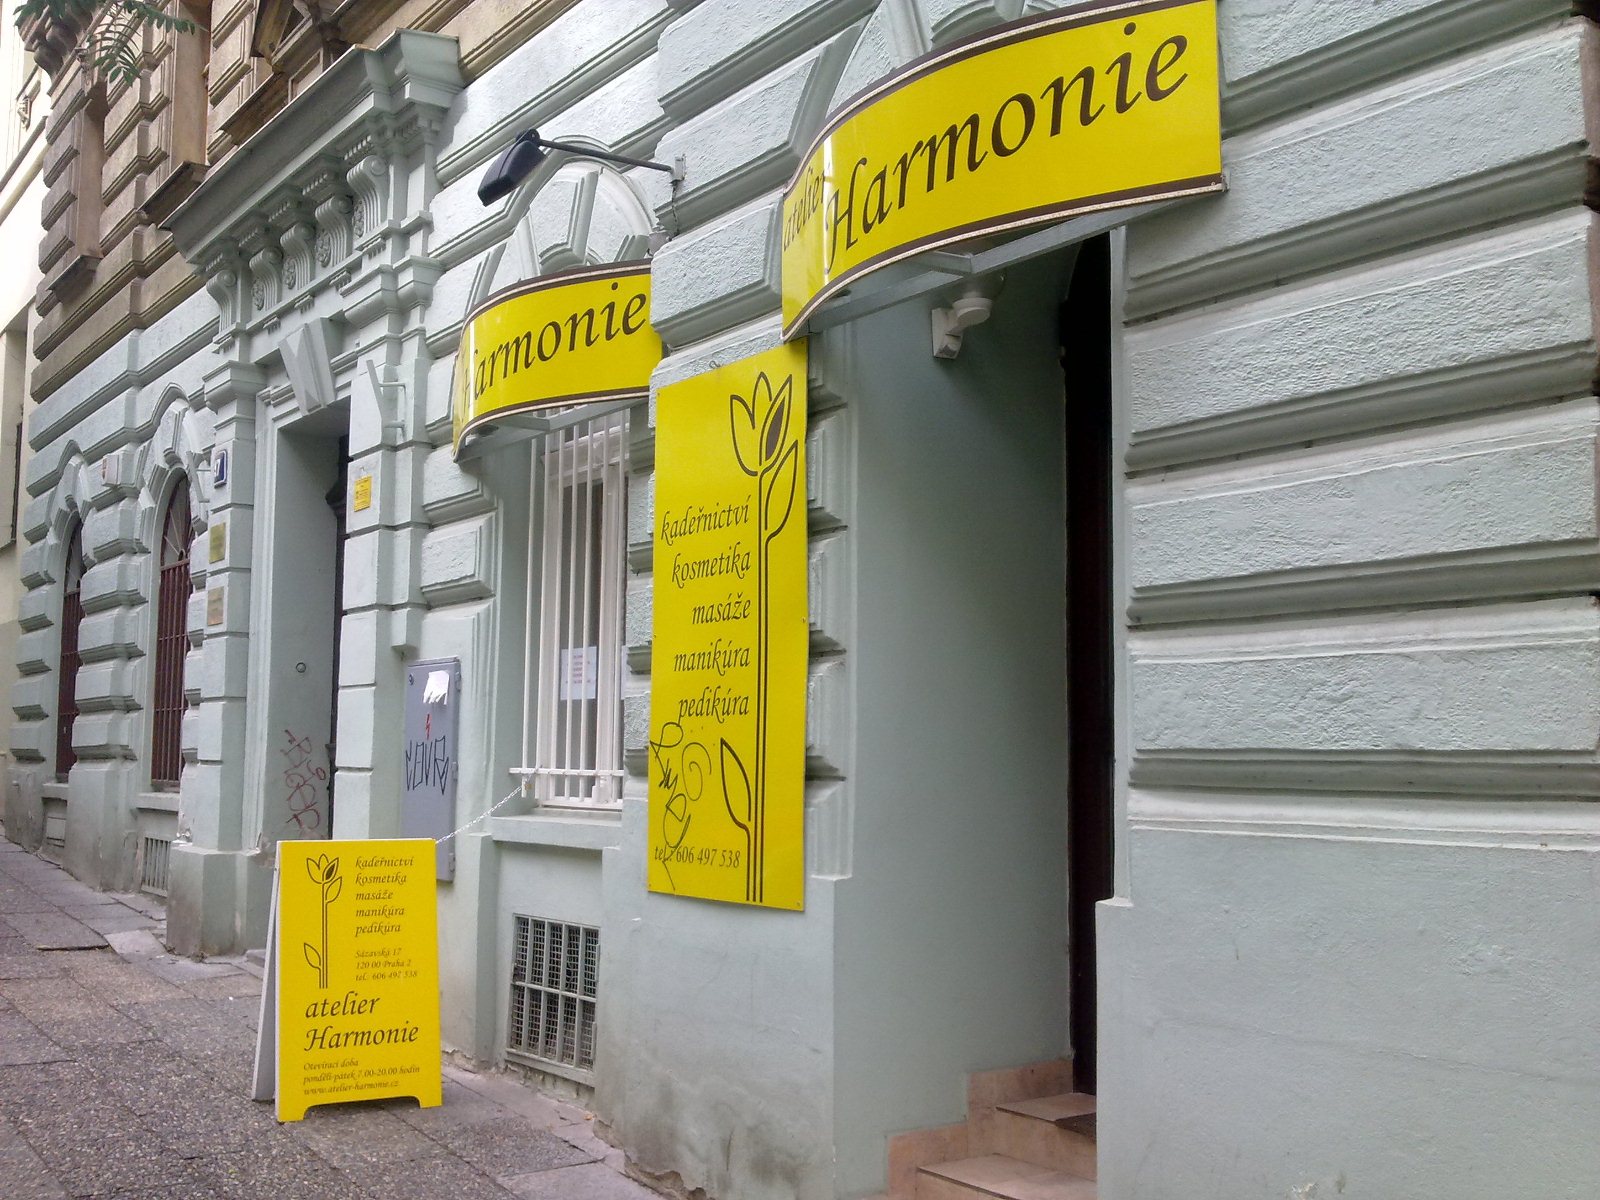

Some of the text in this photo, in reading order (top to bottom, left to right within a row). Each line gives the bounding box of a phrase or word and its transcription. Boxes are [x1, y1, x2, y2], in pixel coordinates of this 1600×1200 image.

[784, 22, 1188, 275] atelier Harmonie
[661, 494, 751, 546] kadeřnictví
[672, 542, 751, 588] kosmetika
[692, 592, 751, 625] masáže
[674, 639, 750, 676] manikúra
[678, 686, 749, 724] pedikúra
[355, 856, 414, 869] kadeřnictví
[676, 846, 695, 864] 606
[697, 848, 717, 866] 497
[719, 850, 741, 868] 538
[355, 872, 407, 885] kosmetika
[355, 889, 393, 900] masáže
[355, 905, 405, 918] manikúra
[355, 922, 401, 937] pedikúra
[305, 991, 380, 1018] atelier
[304, 1020, 419, 1051] Harmonie
